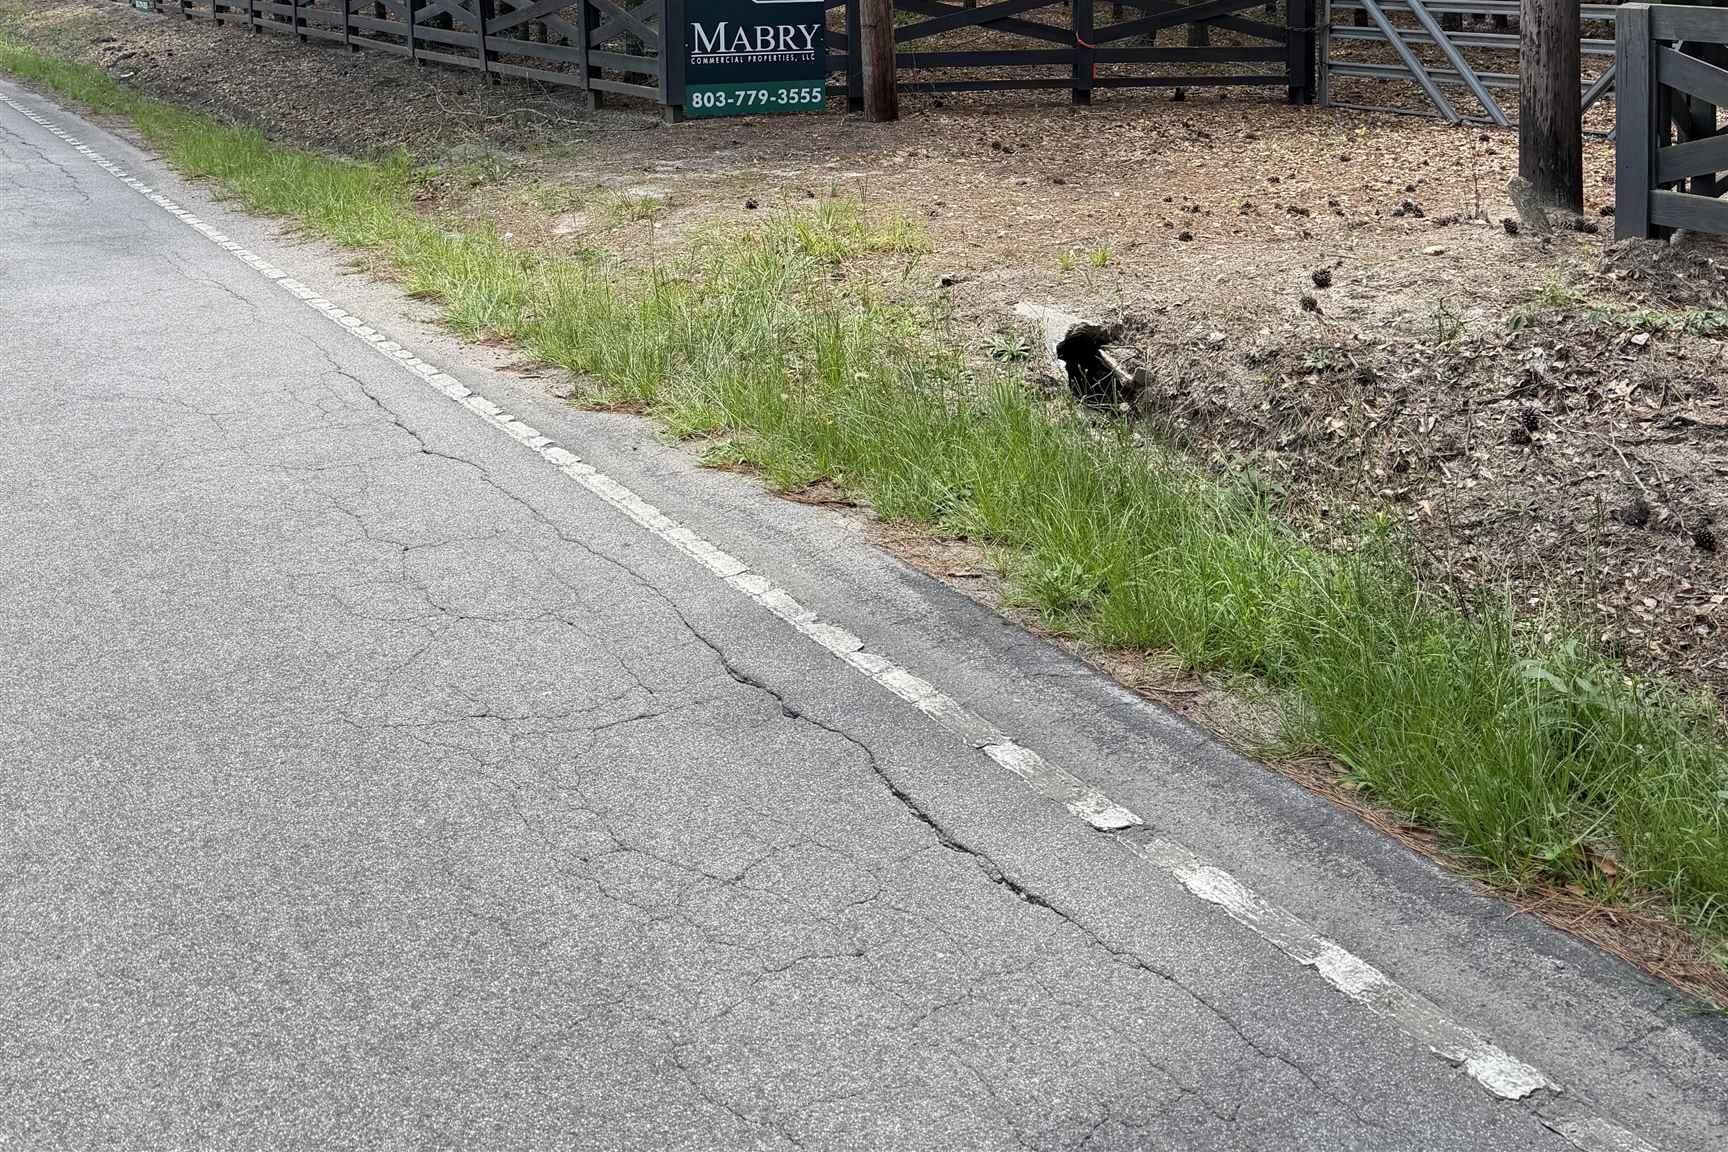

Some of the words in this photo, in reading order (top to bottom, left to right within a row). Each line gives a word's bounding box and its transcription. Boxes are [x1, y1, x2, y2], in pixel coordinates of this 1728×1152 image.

[690, 21, 821, 54] MABRY
[690, 56, 744, 65] COMMERCIAL
[692, 87, 822, 108] 803-779-3555
